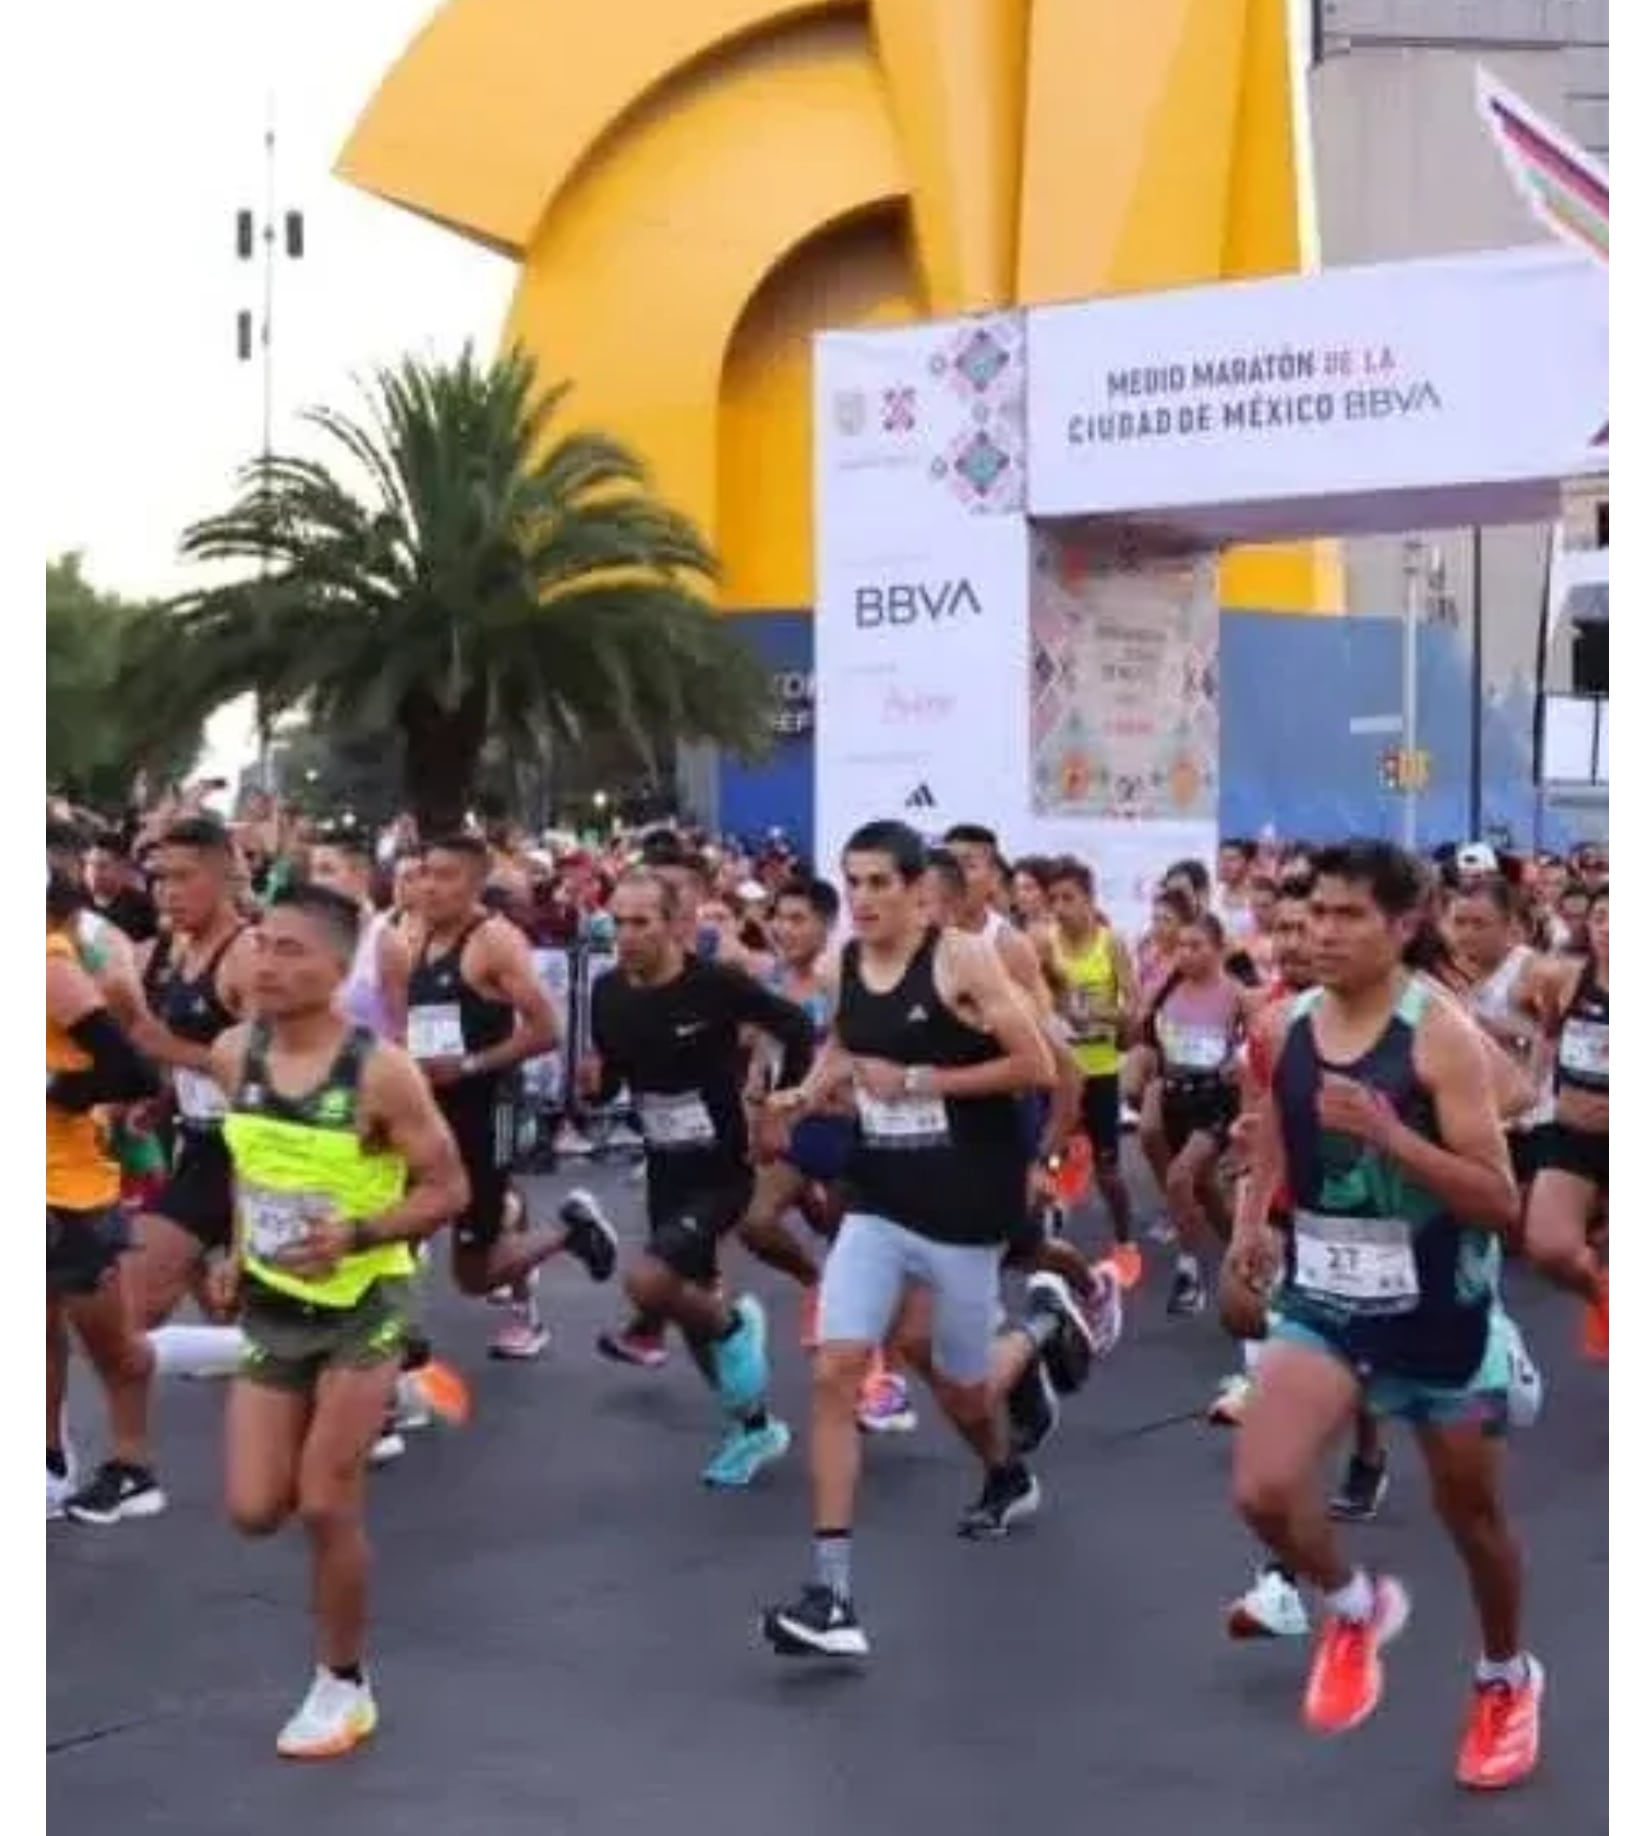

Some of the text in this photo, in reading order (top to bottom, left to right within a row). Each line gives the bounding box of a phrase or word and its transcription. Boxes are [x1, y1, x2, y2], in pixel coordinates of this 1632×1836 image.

[1106, 345, 1396, 397] MEDIO MARATÓN DE LA
[1067, 380, 1442, 444] CIUDAD DE MÉXICO BBVA
[854, 577, 983, 630] BBVA
[1326, 1245, 1359, 1272] 27
